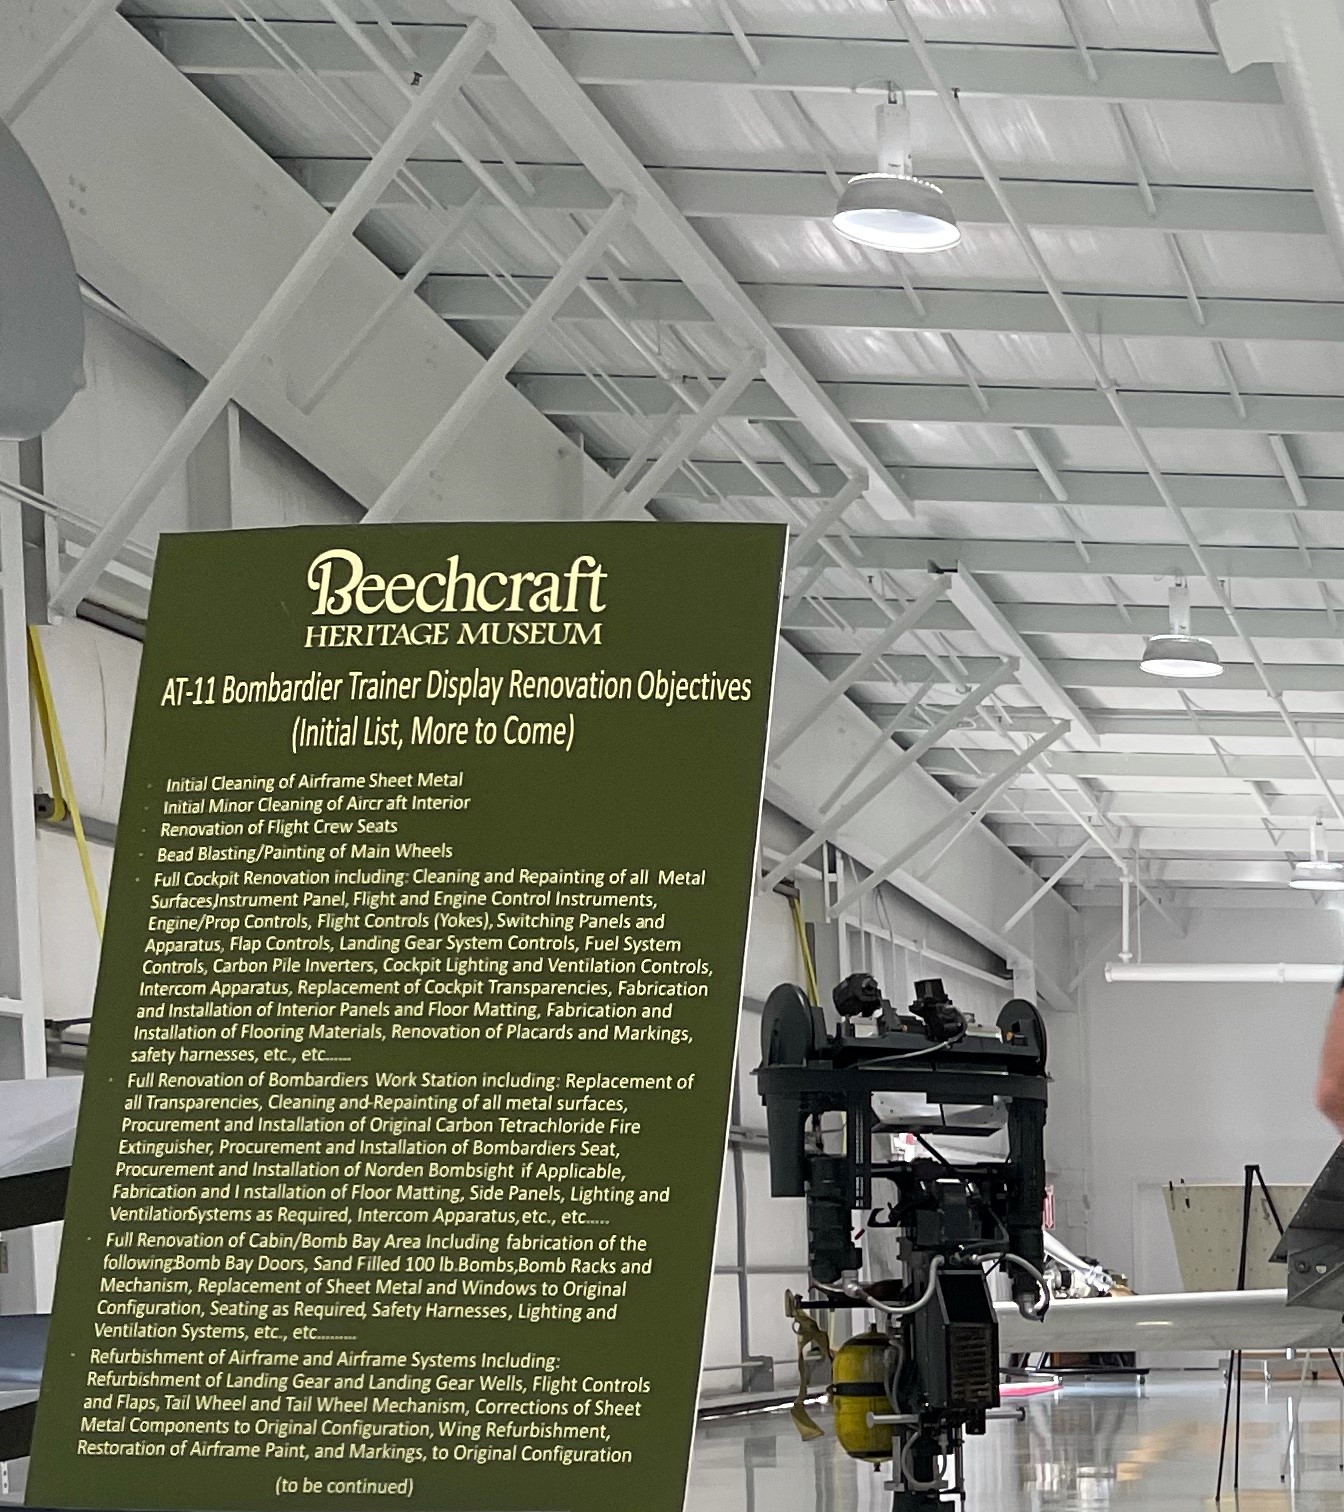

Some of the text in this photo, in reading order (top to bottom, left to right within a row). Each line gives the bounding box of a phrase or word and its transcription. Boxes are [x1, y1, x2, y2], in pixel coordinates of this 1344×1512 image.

[306, 547, 609, 615] Beechcraft
[302, 621, 603, 648] HERITAGE MUSEUM
[159, 666, 752, 707] AT-11 Bombardier Trainer Display Renovation Objectives
[290, 712, 575, 754] (Initial List, More to Come)
[165, 770, 464, 793] Initial Cleaning of Airframe Sheet Metal
[159, 817, 398, 838] Renovation of Flight Crew Seats
[156, 841, 453, 864] Bead Blasting/Painting of Main Wheels
[153, 866, 706, 889] Full Cockpit Renovation including: Cleaning and Repainting of all Metal
[146, 910, 666, 934] Engine/Prop Controls, Flight Controls (Yokes), Switching Panels and
[143, 933, 681, 956] Apparatus, Flap Controls, Landing Gear System Controls, Fuel System
[141, 955, 713, 977] Controls, Carbon Pile Inverters, Cockpit Lighting and Ventilation Controls,
[126, 1069, 696, 1092] Full Renovation of Bombardiers Work Station including: Replacement of
[120, 1114, 641, 1136] Procurement and Installation of Original Carbon Tetrachloride Fire
[105, 1230, 648, 1254] Full Renovation of Cabin/Bomb Bay Area Including fabrication of the
[98, 1275, 627, 1300] Mechanism, Replacement of Sheet Metal and Windows to Original
[89, 1346, 561, 1373] Refurbishment of Airframe and Airframe Systems Including:
[274, 1475, 414, 1498] (to be continued)
